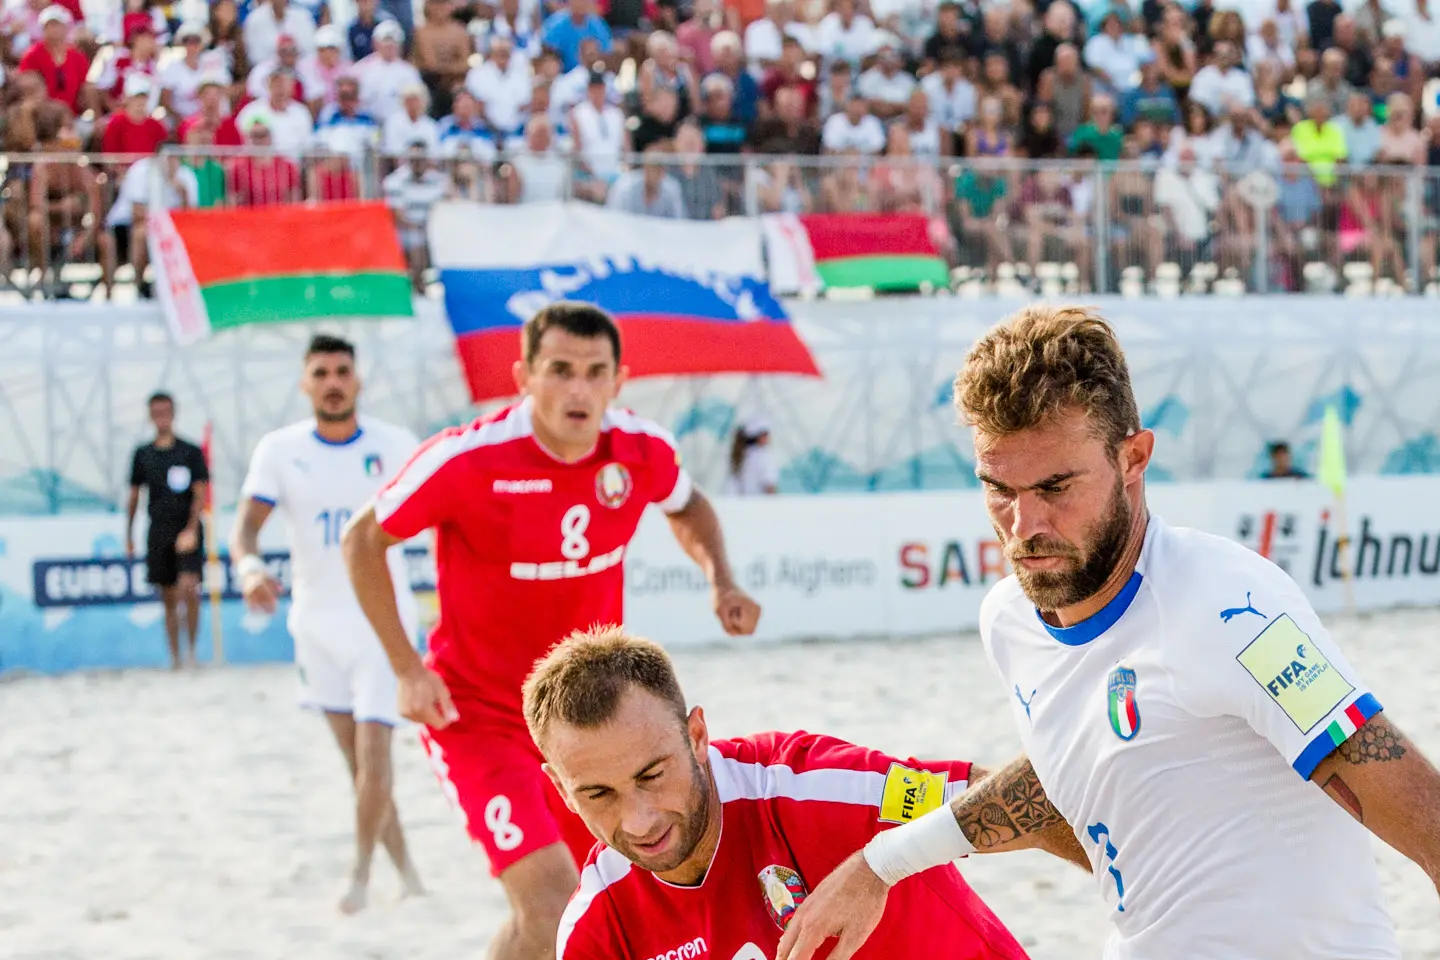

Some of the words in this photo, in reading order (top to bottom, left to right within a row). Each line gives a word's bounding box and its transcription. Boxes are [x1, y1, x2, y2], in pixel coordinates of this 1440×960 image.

[560, 503, 591, 560] 8
[43, 563, 128, 602] EURO
[898, 540, 1008, 591] SAR
[1266, 660, 1307, 698] FIFA
[484, 794, 524, 851] 8
[901, 787, 917, 819] FIFA
